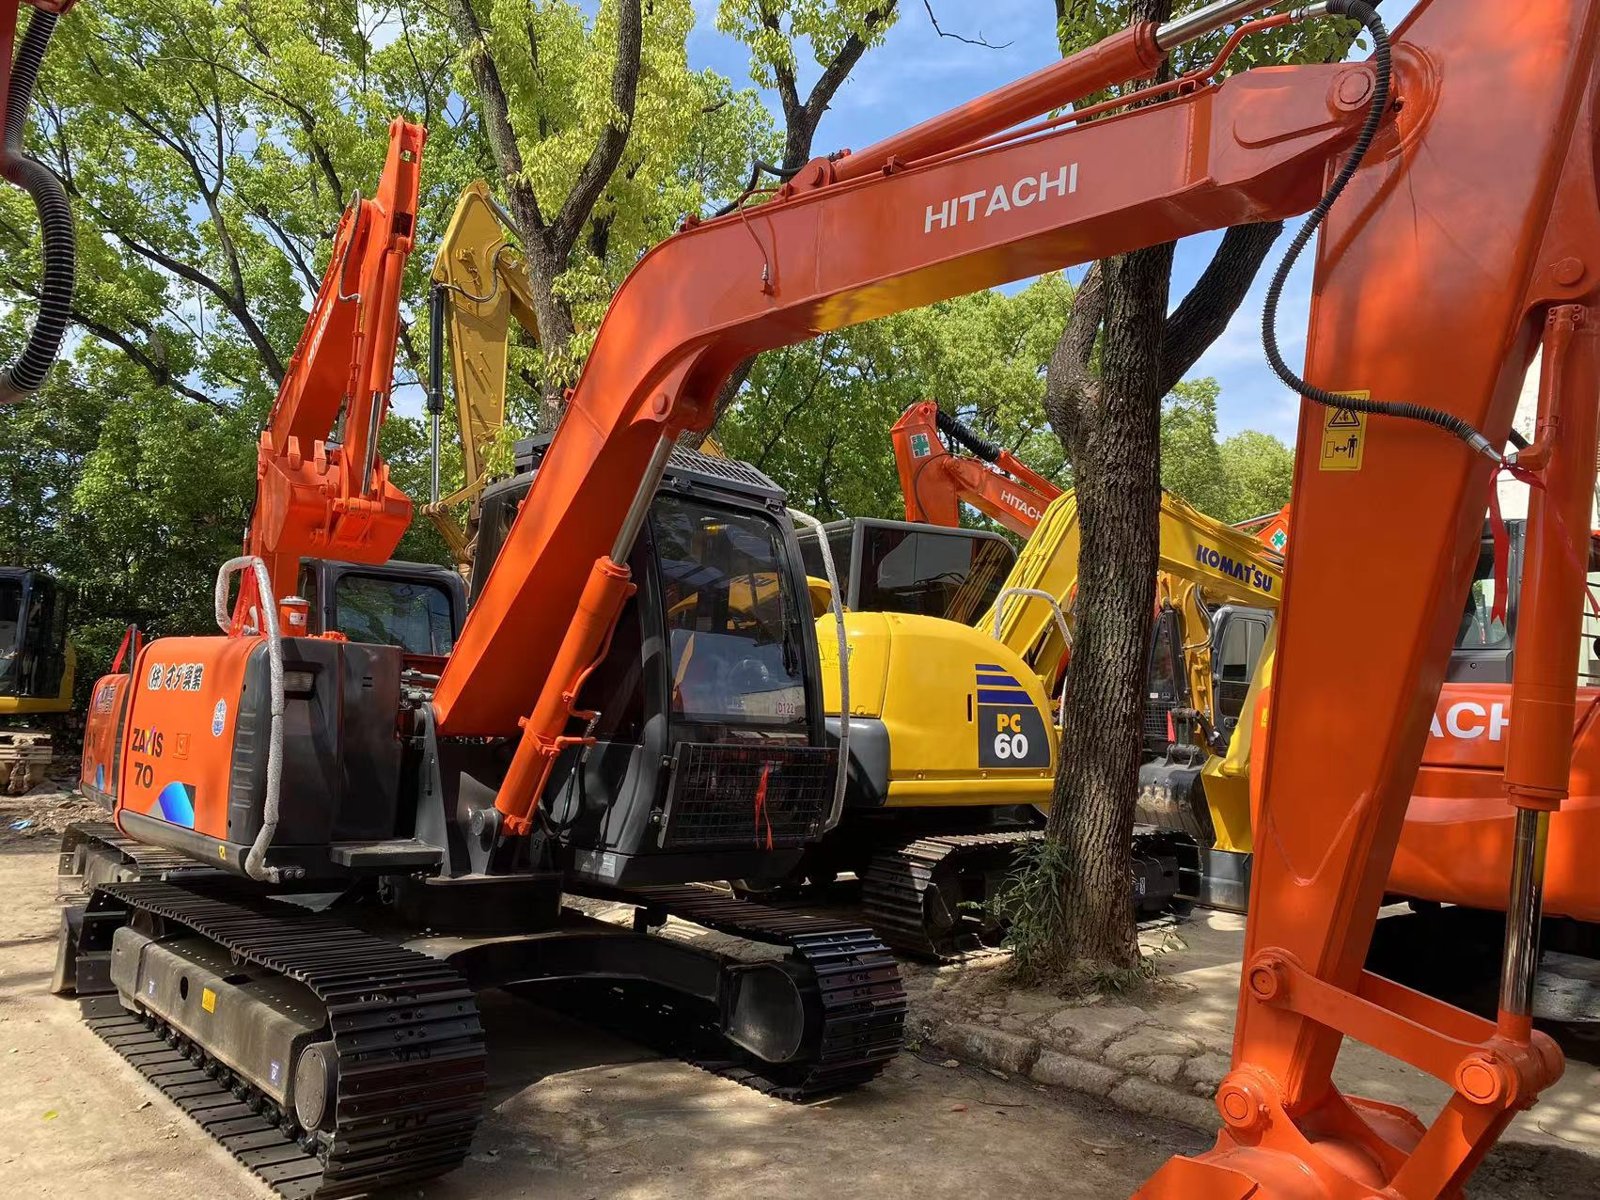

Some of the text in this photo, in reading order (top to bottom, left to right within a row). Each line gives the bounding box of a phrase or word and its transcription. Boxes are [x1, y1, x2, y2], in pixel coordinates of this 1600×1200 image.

[924, 163, 1078, 234] HITACHI
[1196, 543, 1273, 593] KOMATSU
[997, 713, 1021, 733] PC
[131, 725, 164, 758] ZAXIS
[994, 733, 1029, 759] 60
[134, 761, 154, 789] 70
